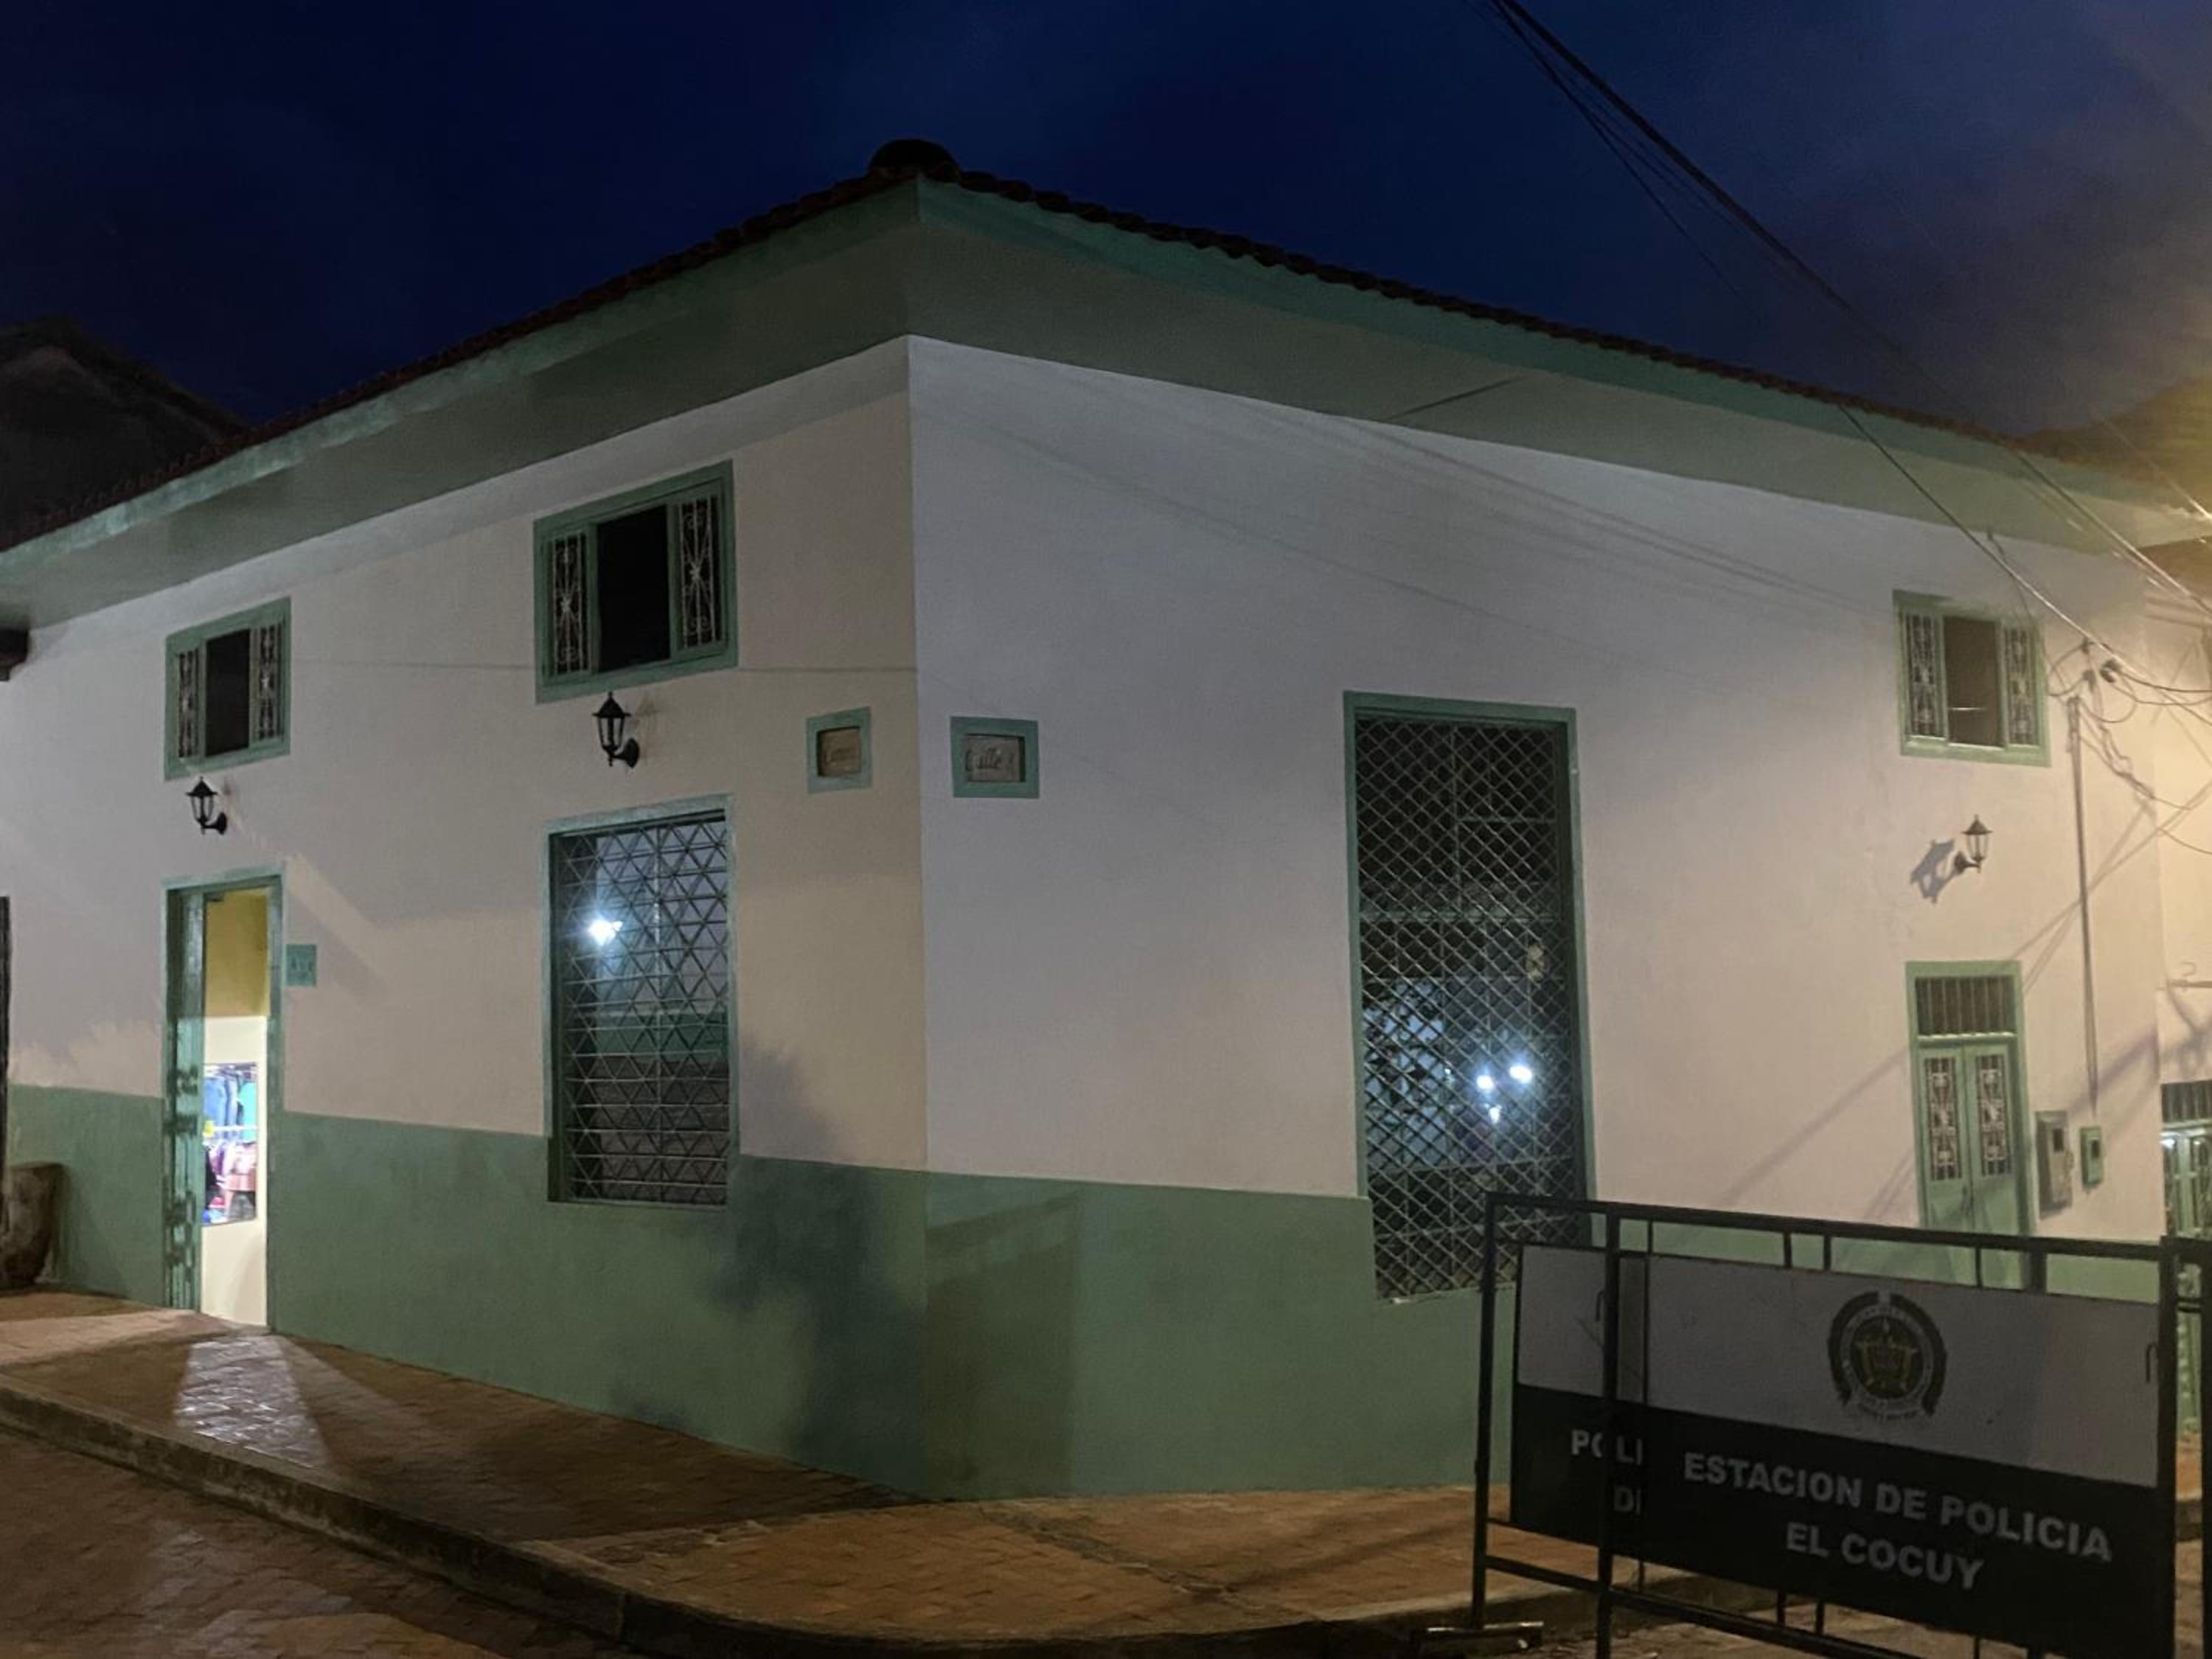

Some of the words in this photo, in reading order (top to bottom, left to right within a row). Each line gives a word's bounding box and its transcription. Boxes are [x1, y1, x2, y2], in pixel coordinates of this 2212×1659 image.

[1683, 1452, 1862, 1507] ESTACION
[1876, 1483, 1927, 1520] DE
[1939, 1495, 2112, 1562] POLICIA
[1786, 1521, 1829, 1557] EL
[1840, 1531, 1984, 1590] COCUY
